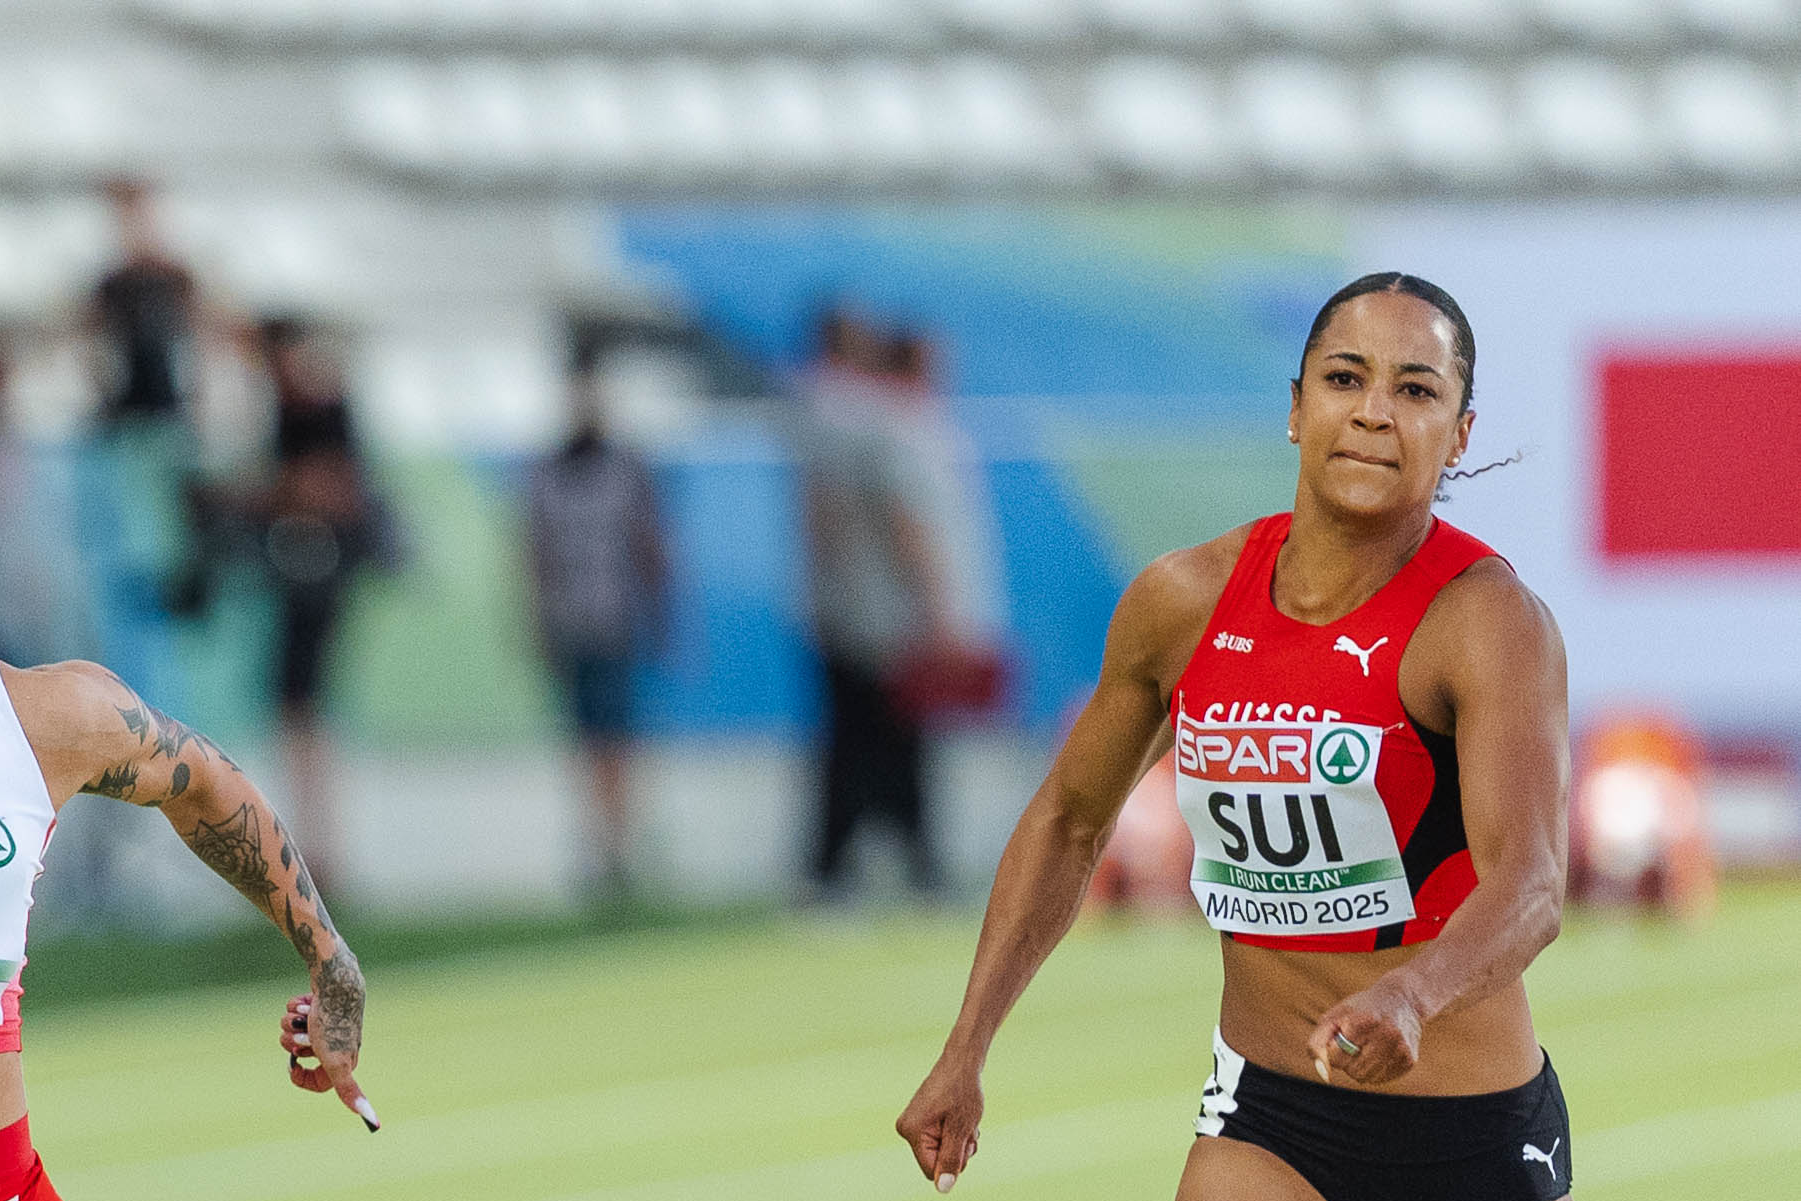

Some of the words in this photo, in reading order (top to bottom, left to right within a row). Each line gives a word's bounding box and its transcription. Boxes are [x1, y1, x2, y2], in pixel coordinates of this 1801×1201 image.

[1227, 634, 1254, 653] UBS
[1179, 729, 1307, 775] SPAR
[1208, 791, 1344, 867] SUI
[1237, 869, 1268, 891] RUN
[1206, 892, 1308, 925] MADRID
[1314, 889, 1389, 924] 2025
